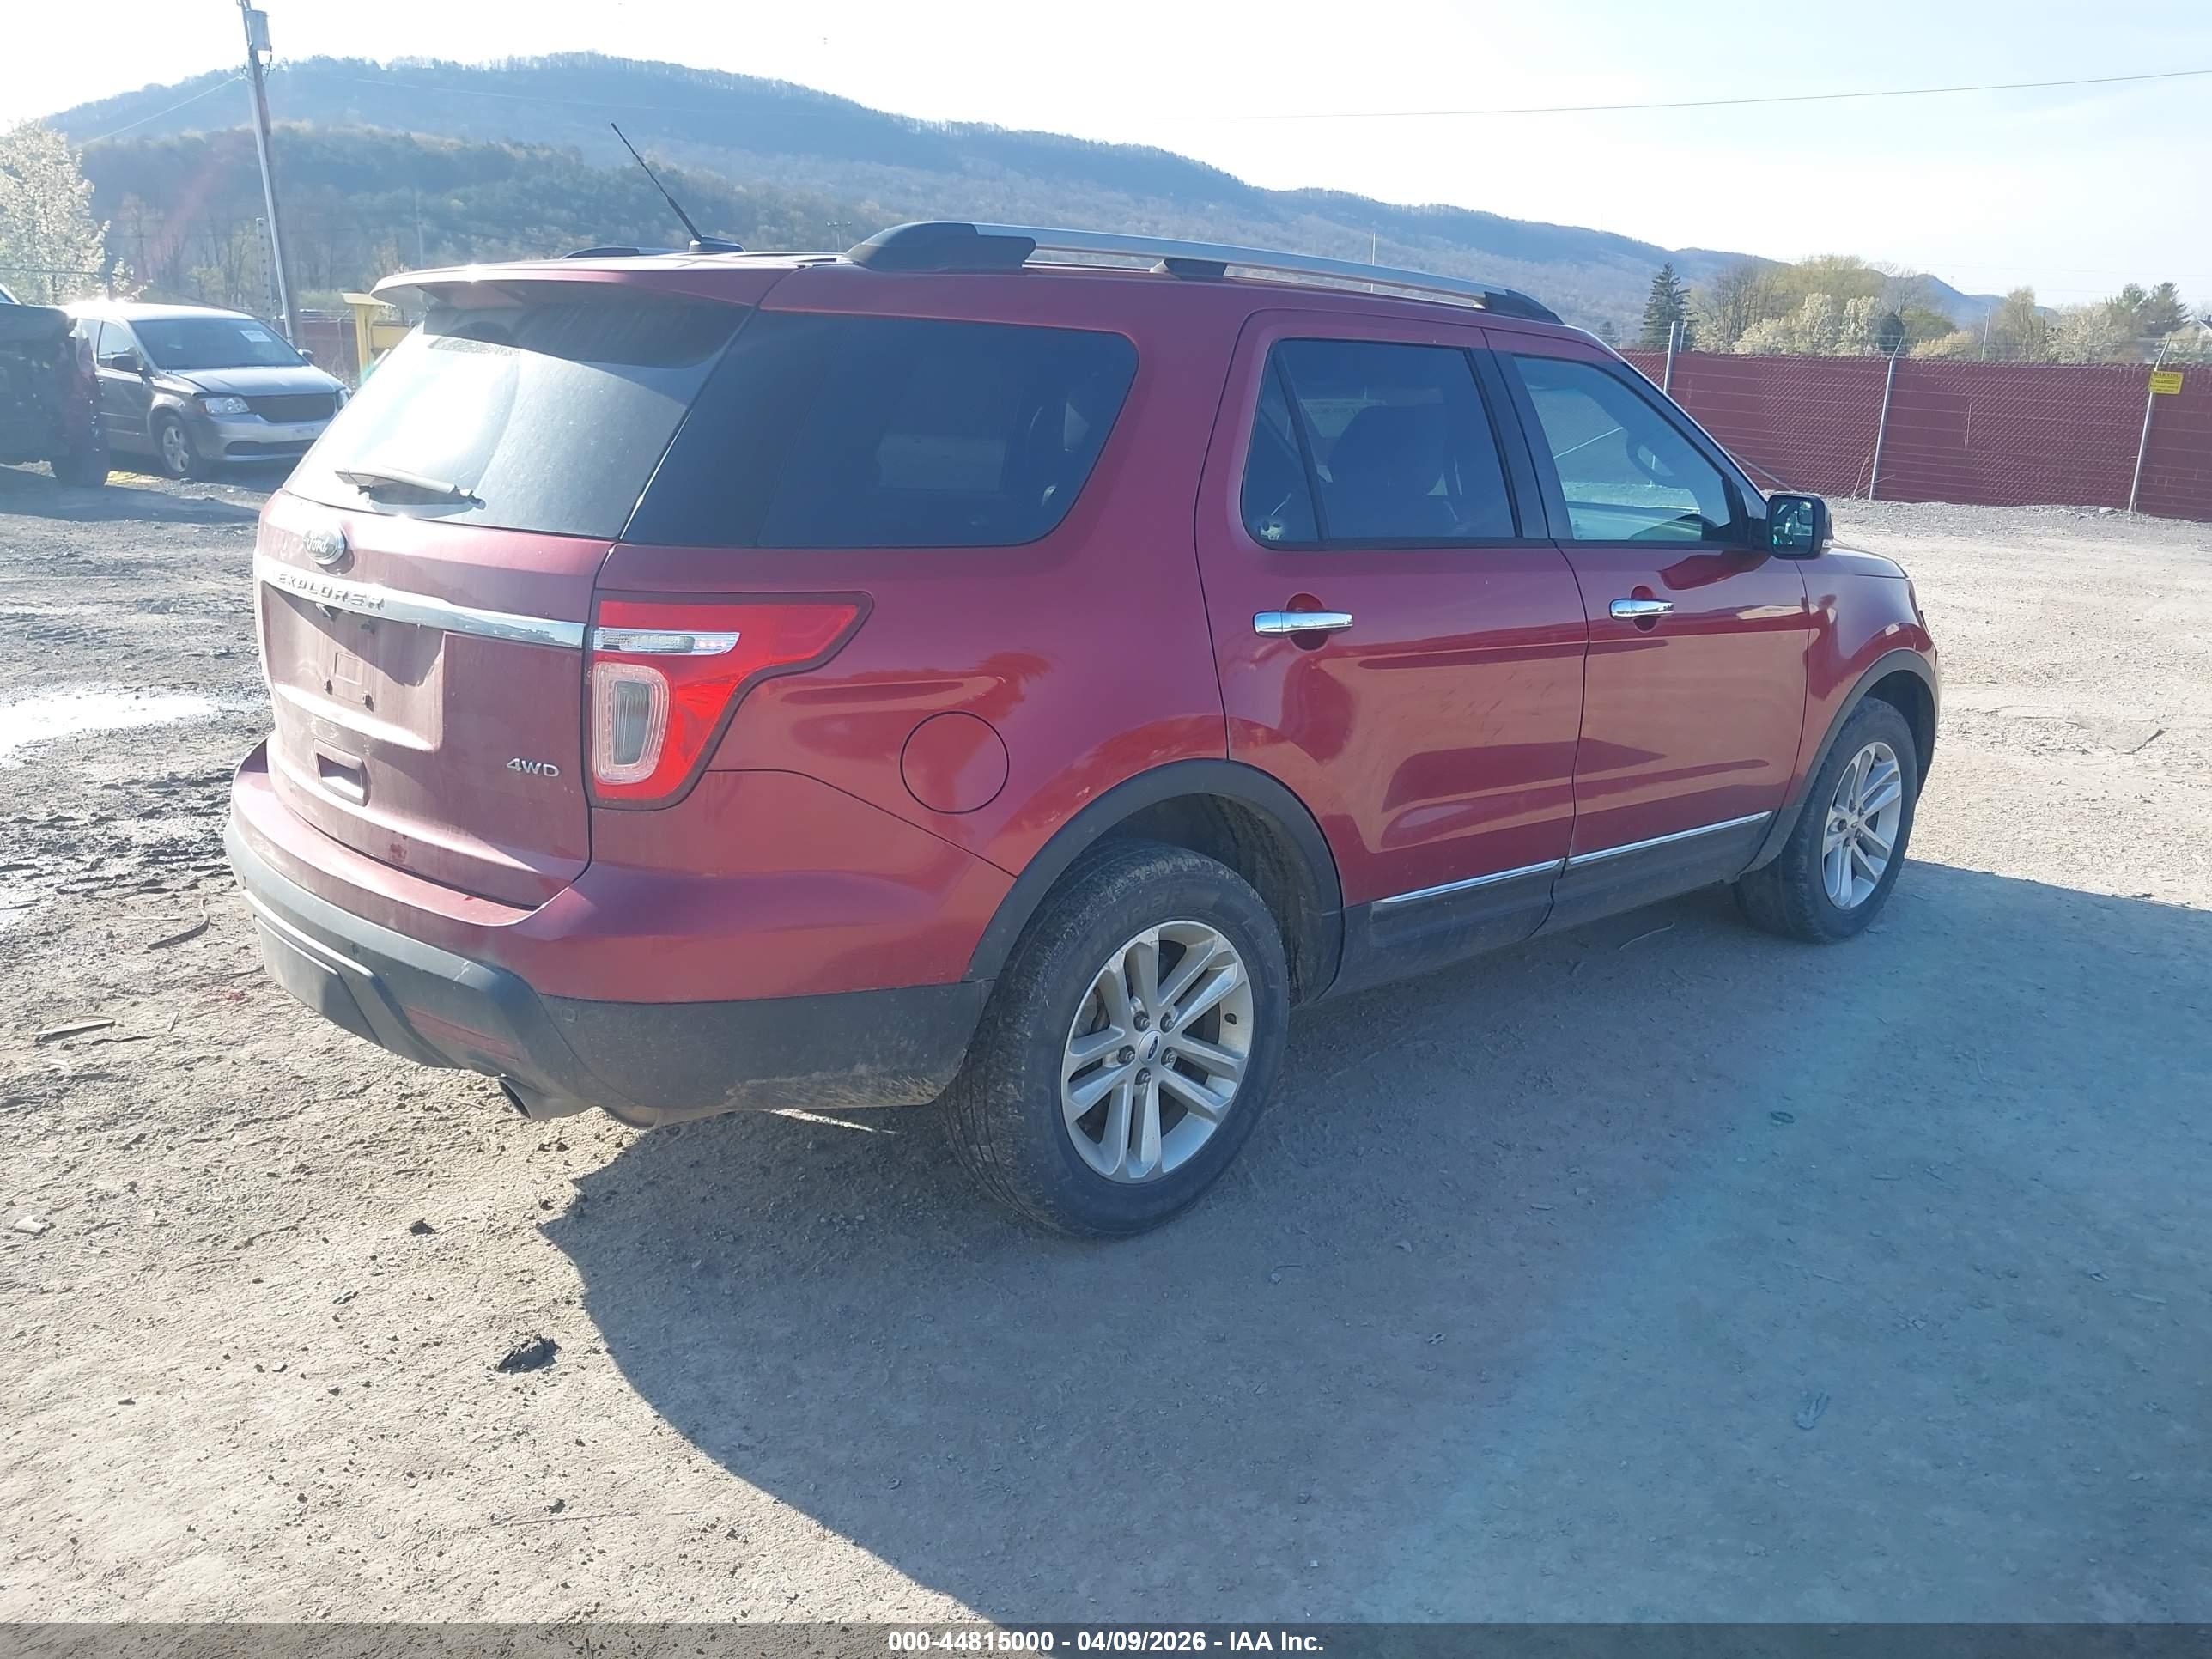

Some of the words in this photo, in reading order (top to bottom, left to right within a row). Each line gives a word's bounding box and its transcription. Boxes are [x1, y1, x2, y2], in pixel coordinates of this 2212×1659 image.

[303, 536, 330, 553] Ford
[277, 573, 385, 611] EXPLORER
[507, 757, 559, 777] 4WD
